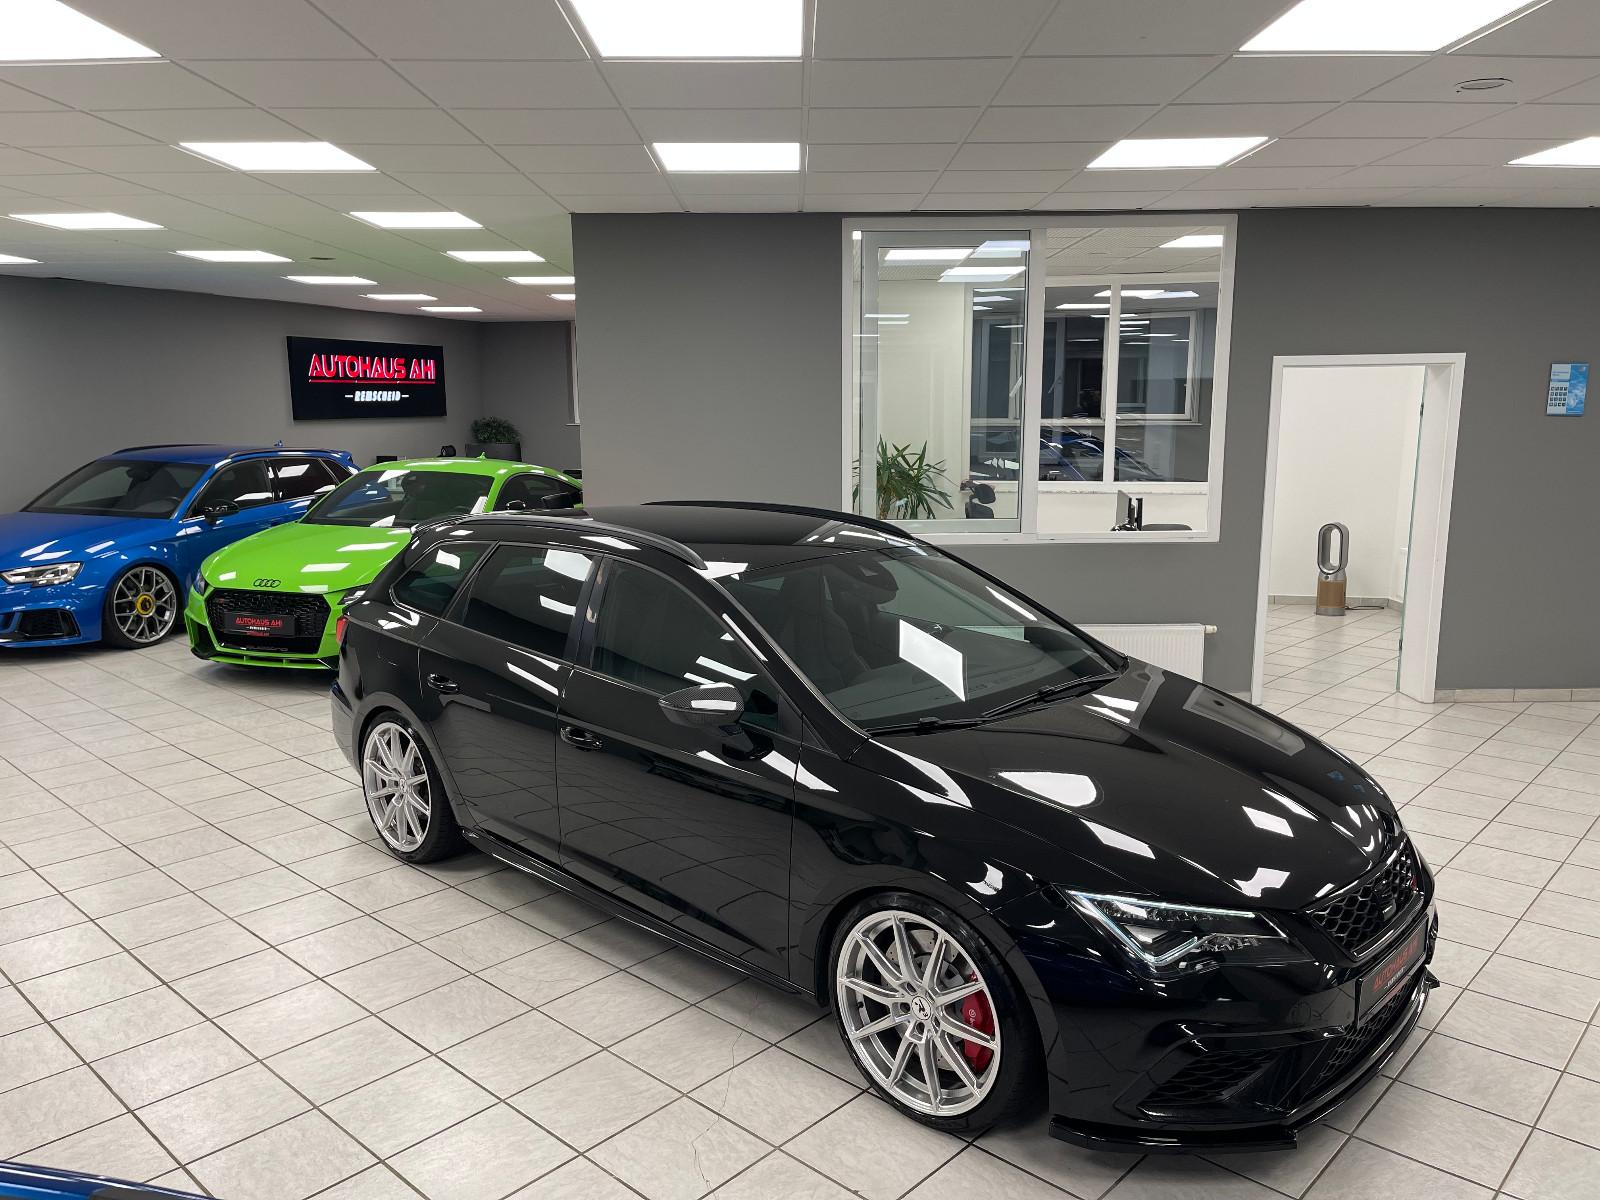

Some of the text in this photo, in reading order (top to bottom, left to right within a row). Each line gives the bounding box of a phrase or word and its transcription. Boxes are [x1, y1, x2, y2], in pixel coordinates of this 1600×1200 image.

[308, 353, 406, 379] AUTOHAUS
[354, 390, 401, 402] REMSCHEID
[235, 616, 270, 626] AUTOHAUS
